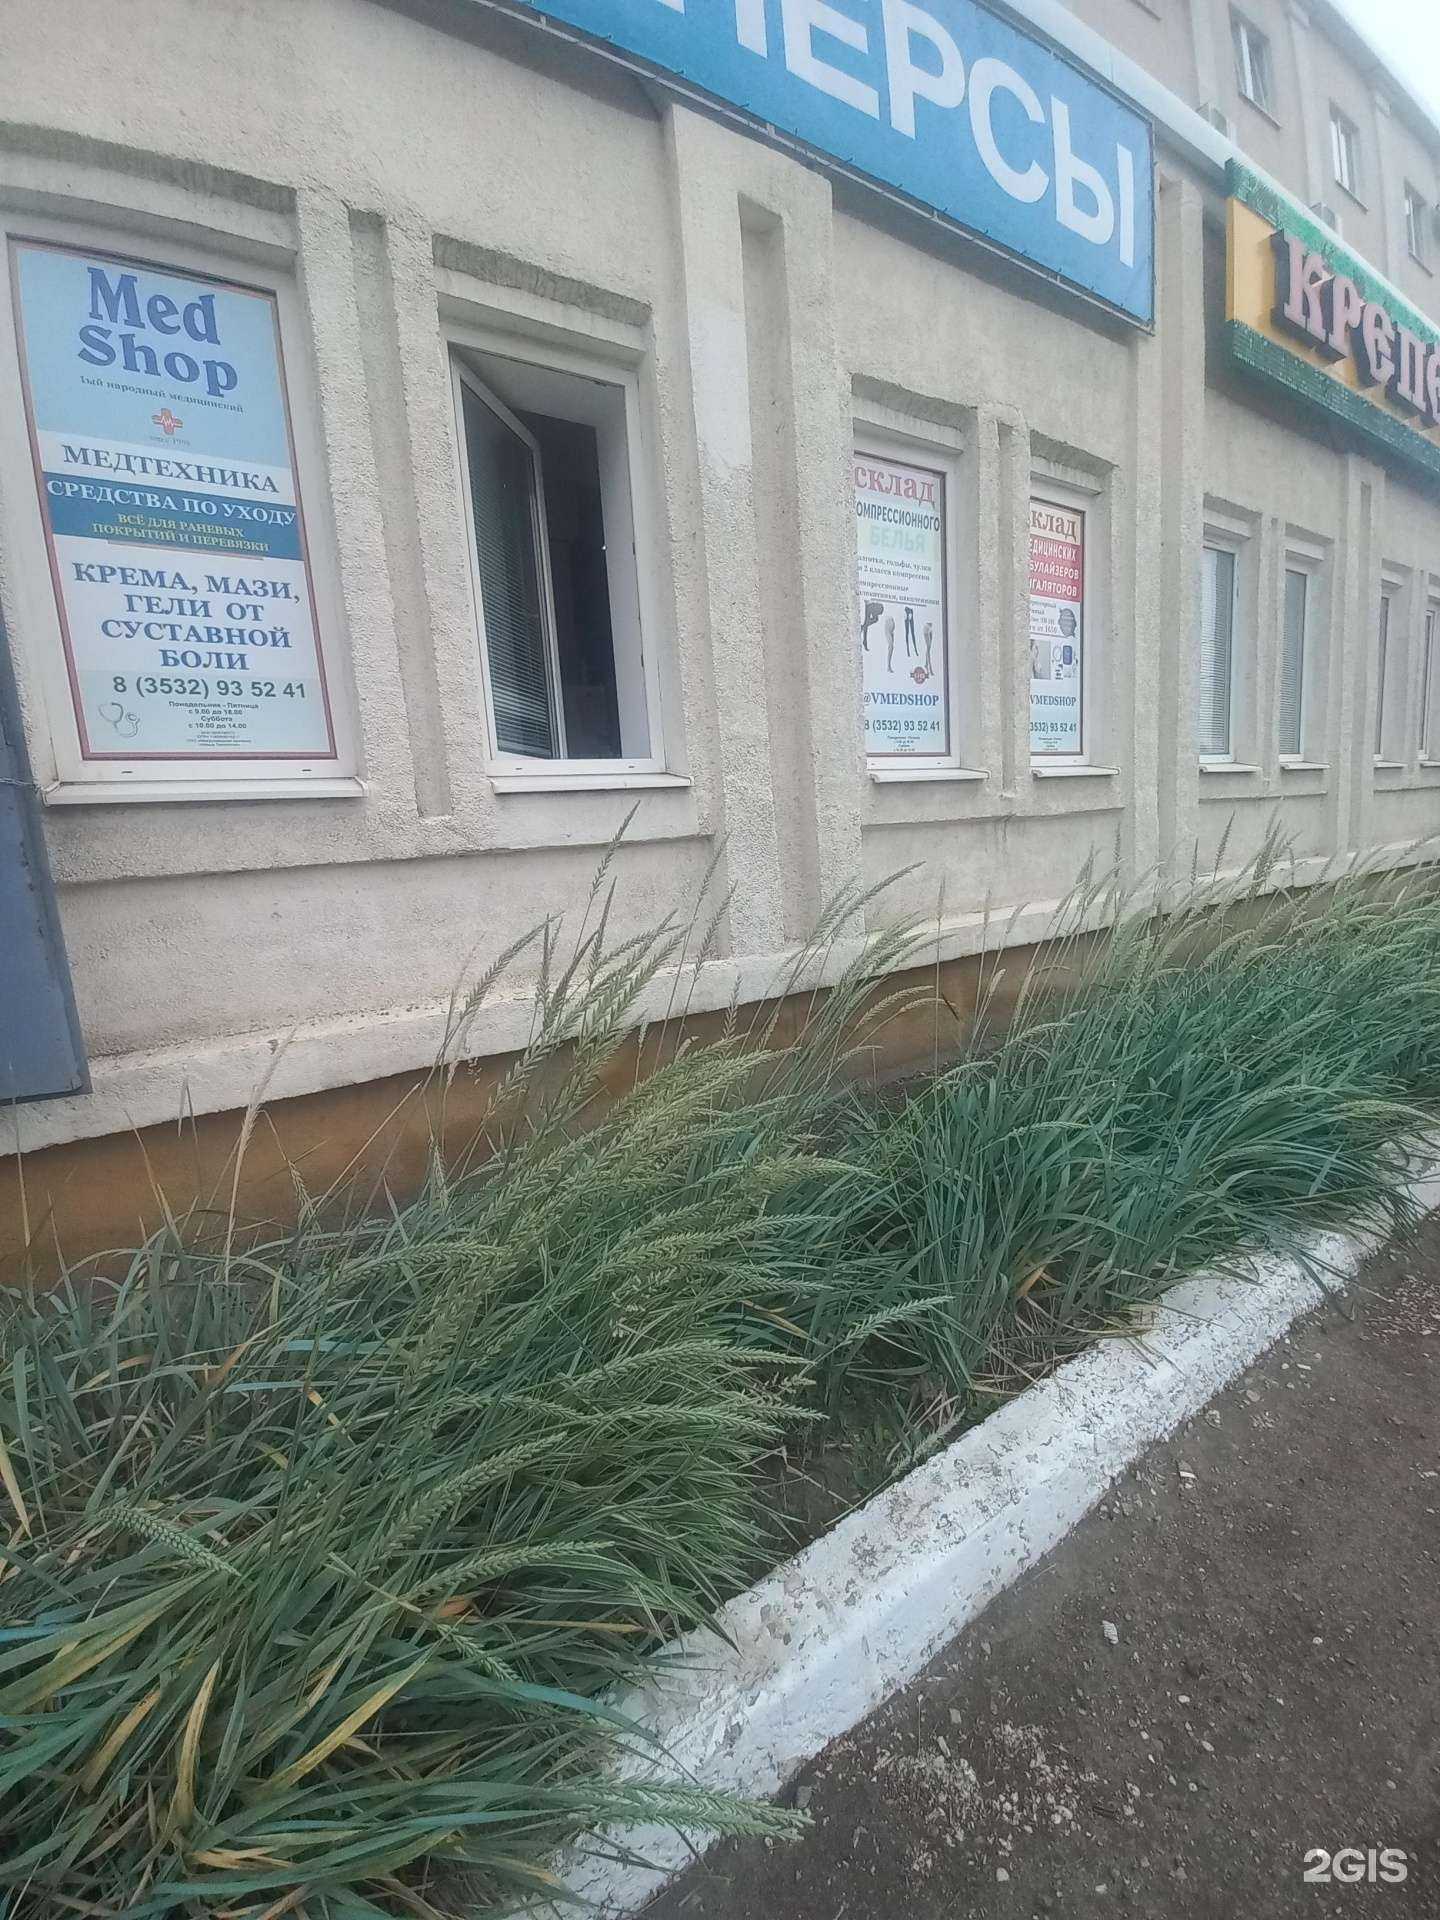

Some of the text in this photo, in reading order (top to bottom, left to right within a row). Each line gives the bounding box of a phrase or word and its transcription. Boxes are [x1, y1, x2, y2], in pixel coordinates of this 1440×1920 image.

[87, 266, 221, 346] Med
[78, 324, 238, 398] Shop
[61, 444, 280, 494] МЕДТЕХНИКА
[47, 480, 297, 526] СРЕДСТВА ПО УХОДУ
[856, 500, 940, 532] ОМПРЕССИОННОГО
[92, 523, 177, 542] ПОКРЫТИЙ
[191, 534, 269, 552] ПЕРЕВЯЗКИ
[148, 516, 177, 530] ДЛЯ
[180, 520, 245, 538] РАНЕВЫХ
[1031, 510, 1077, 543] клад
[1030, 539, 1077, 562] ДИЦИНСКИХ
[71, 561, 300, 603] КРЕМА, МАЗИ,
[1030, 560, 1080, 580] БУЛАЙЗЕРОВ
[1029, 578, 1077, 597] ГАЛЯТОРОВ
[124, 593, 264, 622] ГЕЛИ ОТ
[101, 619, 292, 649] СУСТАВНОЙ
[158, 648, 250, 671] БОЛИ
[112, 676, 305, 699] 8 (3532) 93 52 41
[864, 692, 939, 706] @VMEDSHOP
[1030, 694, 1076, 706] VMEDSHOP
[873, 720, 901, 733] (3532)
[904, 720, 915, 731] 93
[917, 720, 928, 731] 52
[930, 720, 940, 731] 41
[1030, 722, 1048, 734] 3532)
